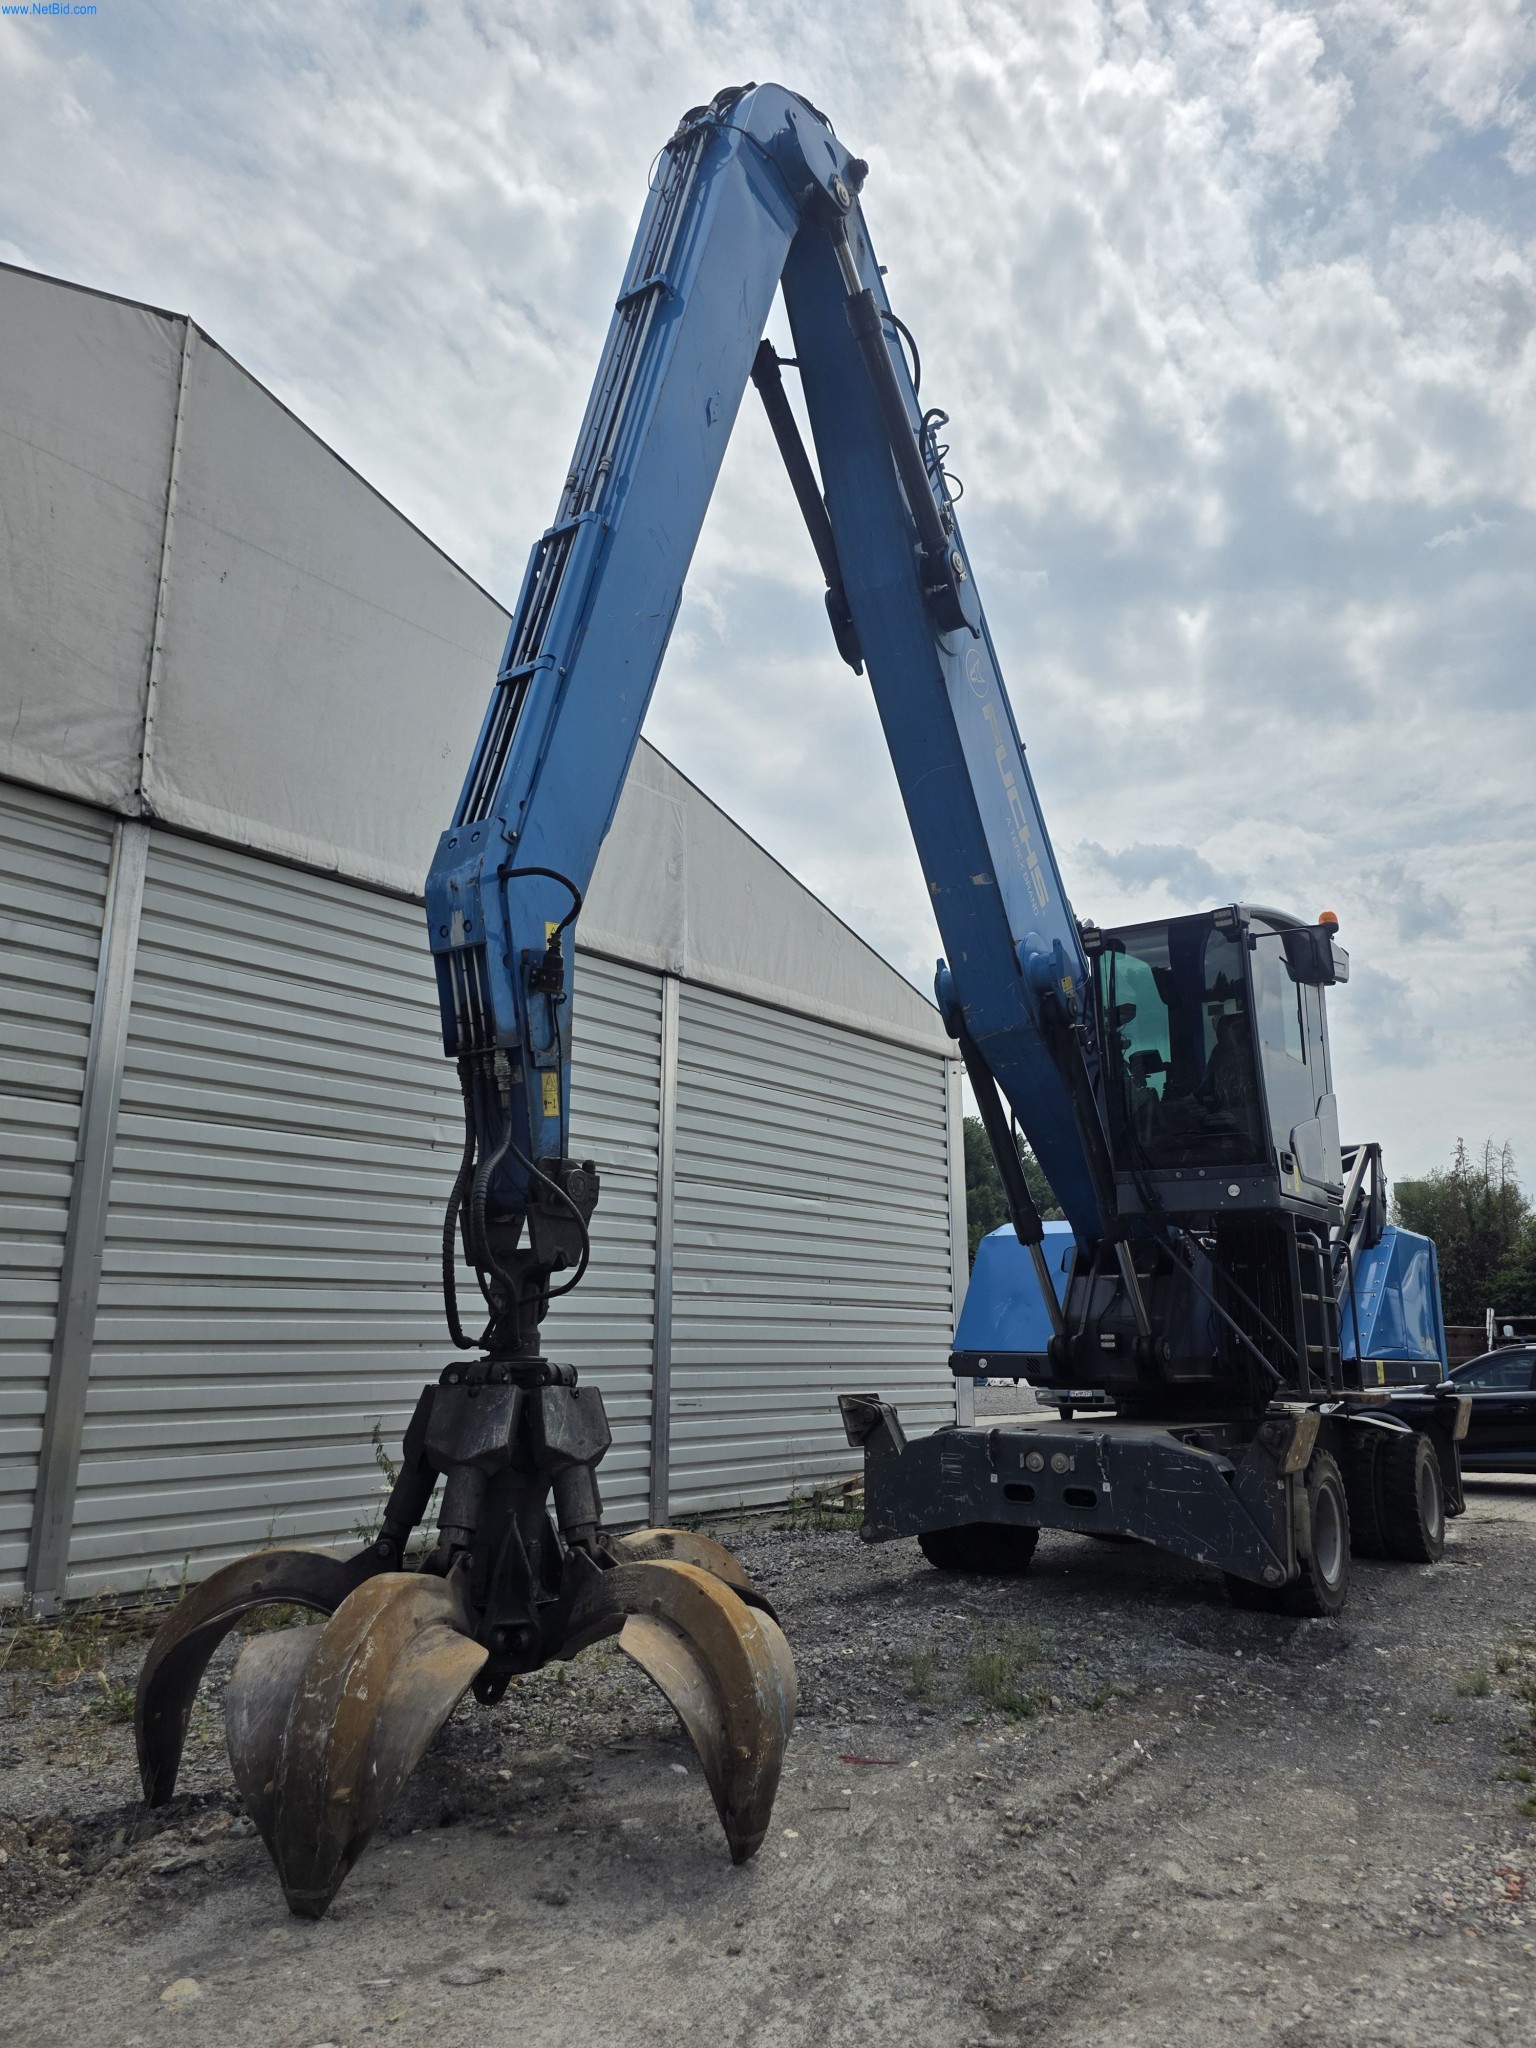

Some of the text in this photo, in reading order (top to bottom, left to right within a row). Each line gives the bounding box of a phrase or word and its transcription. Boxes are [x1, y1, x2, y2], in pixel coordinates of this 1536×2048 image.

[982, 703, 1050, 909] FUCHS
[1010, 830, 1026, 870] TEREX
[1022, 871, 1040, 917] BRAND
